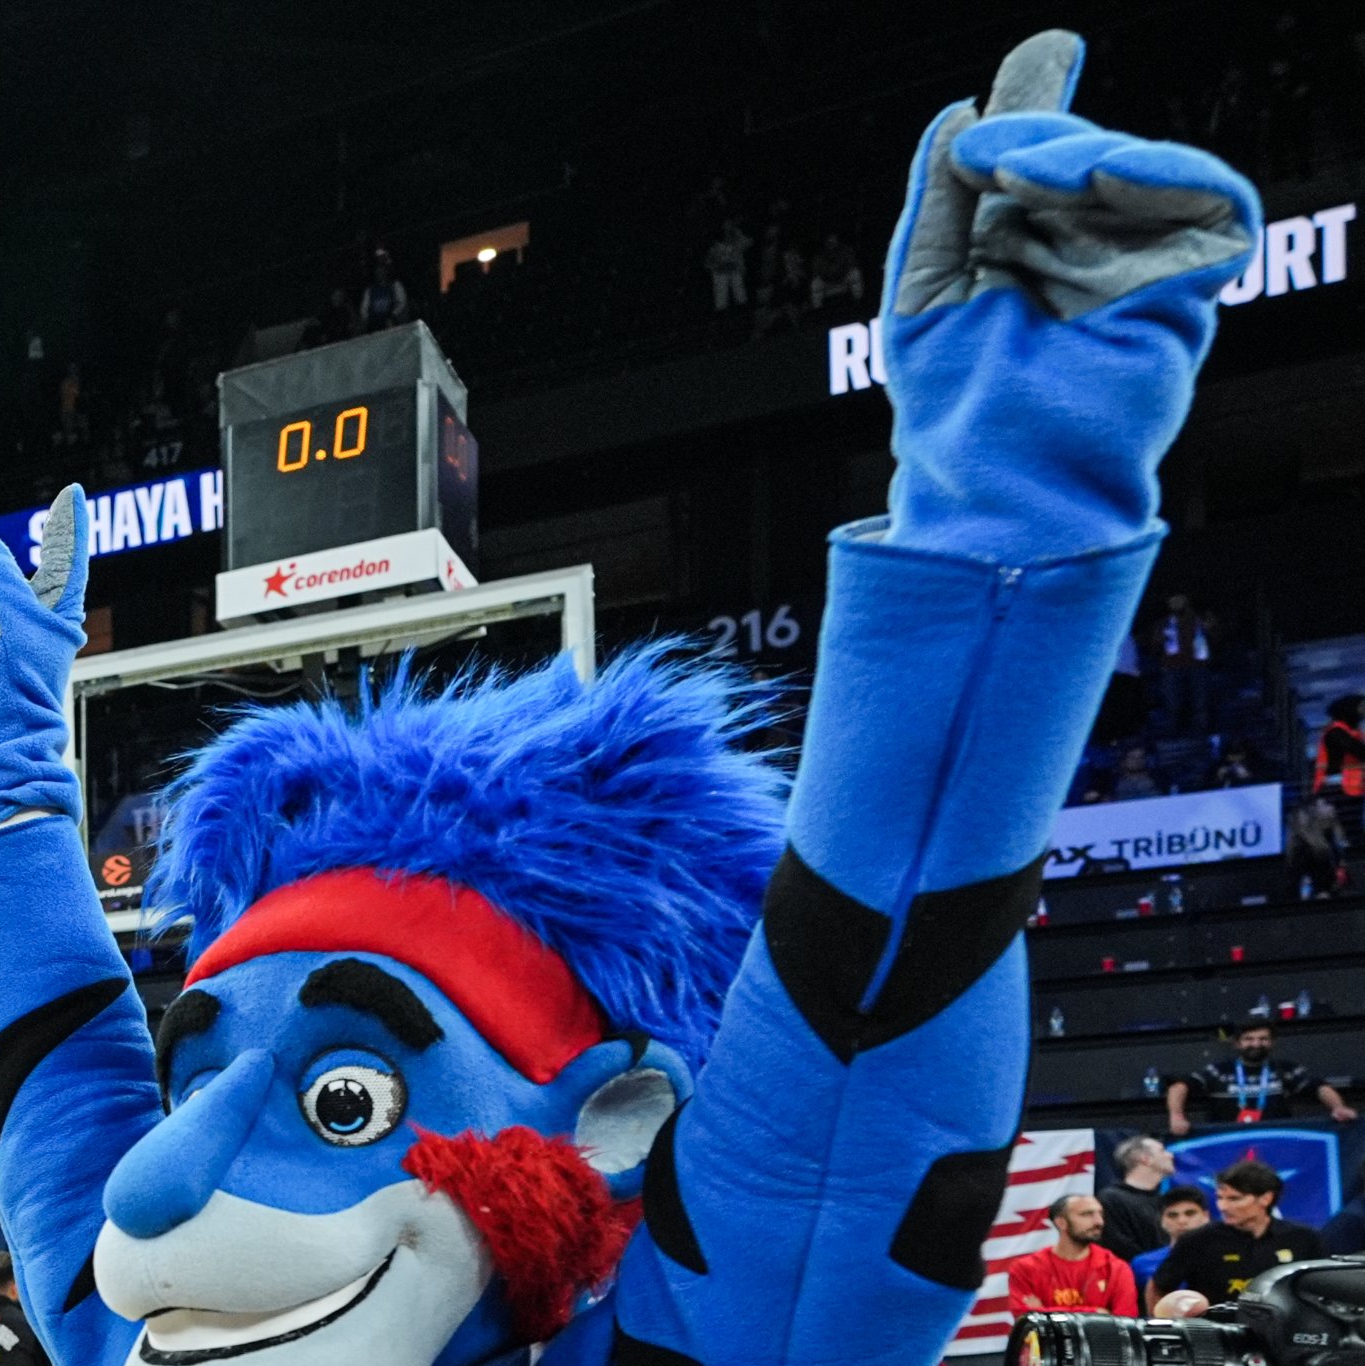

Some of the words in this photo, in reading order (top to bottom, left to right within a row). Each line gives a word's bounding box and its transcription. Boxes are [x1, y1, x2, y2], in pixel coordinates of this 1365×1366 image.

[1216, 203, 1356, 306] URT
[277, 406, 369, 473] 0.0
[28, 479, 191, 569] SHAYA
[294, 554, 391, 592] corendon
[708, 604, 800, 658] 216
[1110, 820, 1263, 859] TRİBÜNÜ
